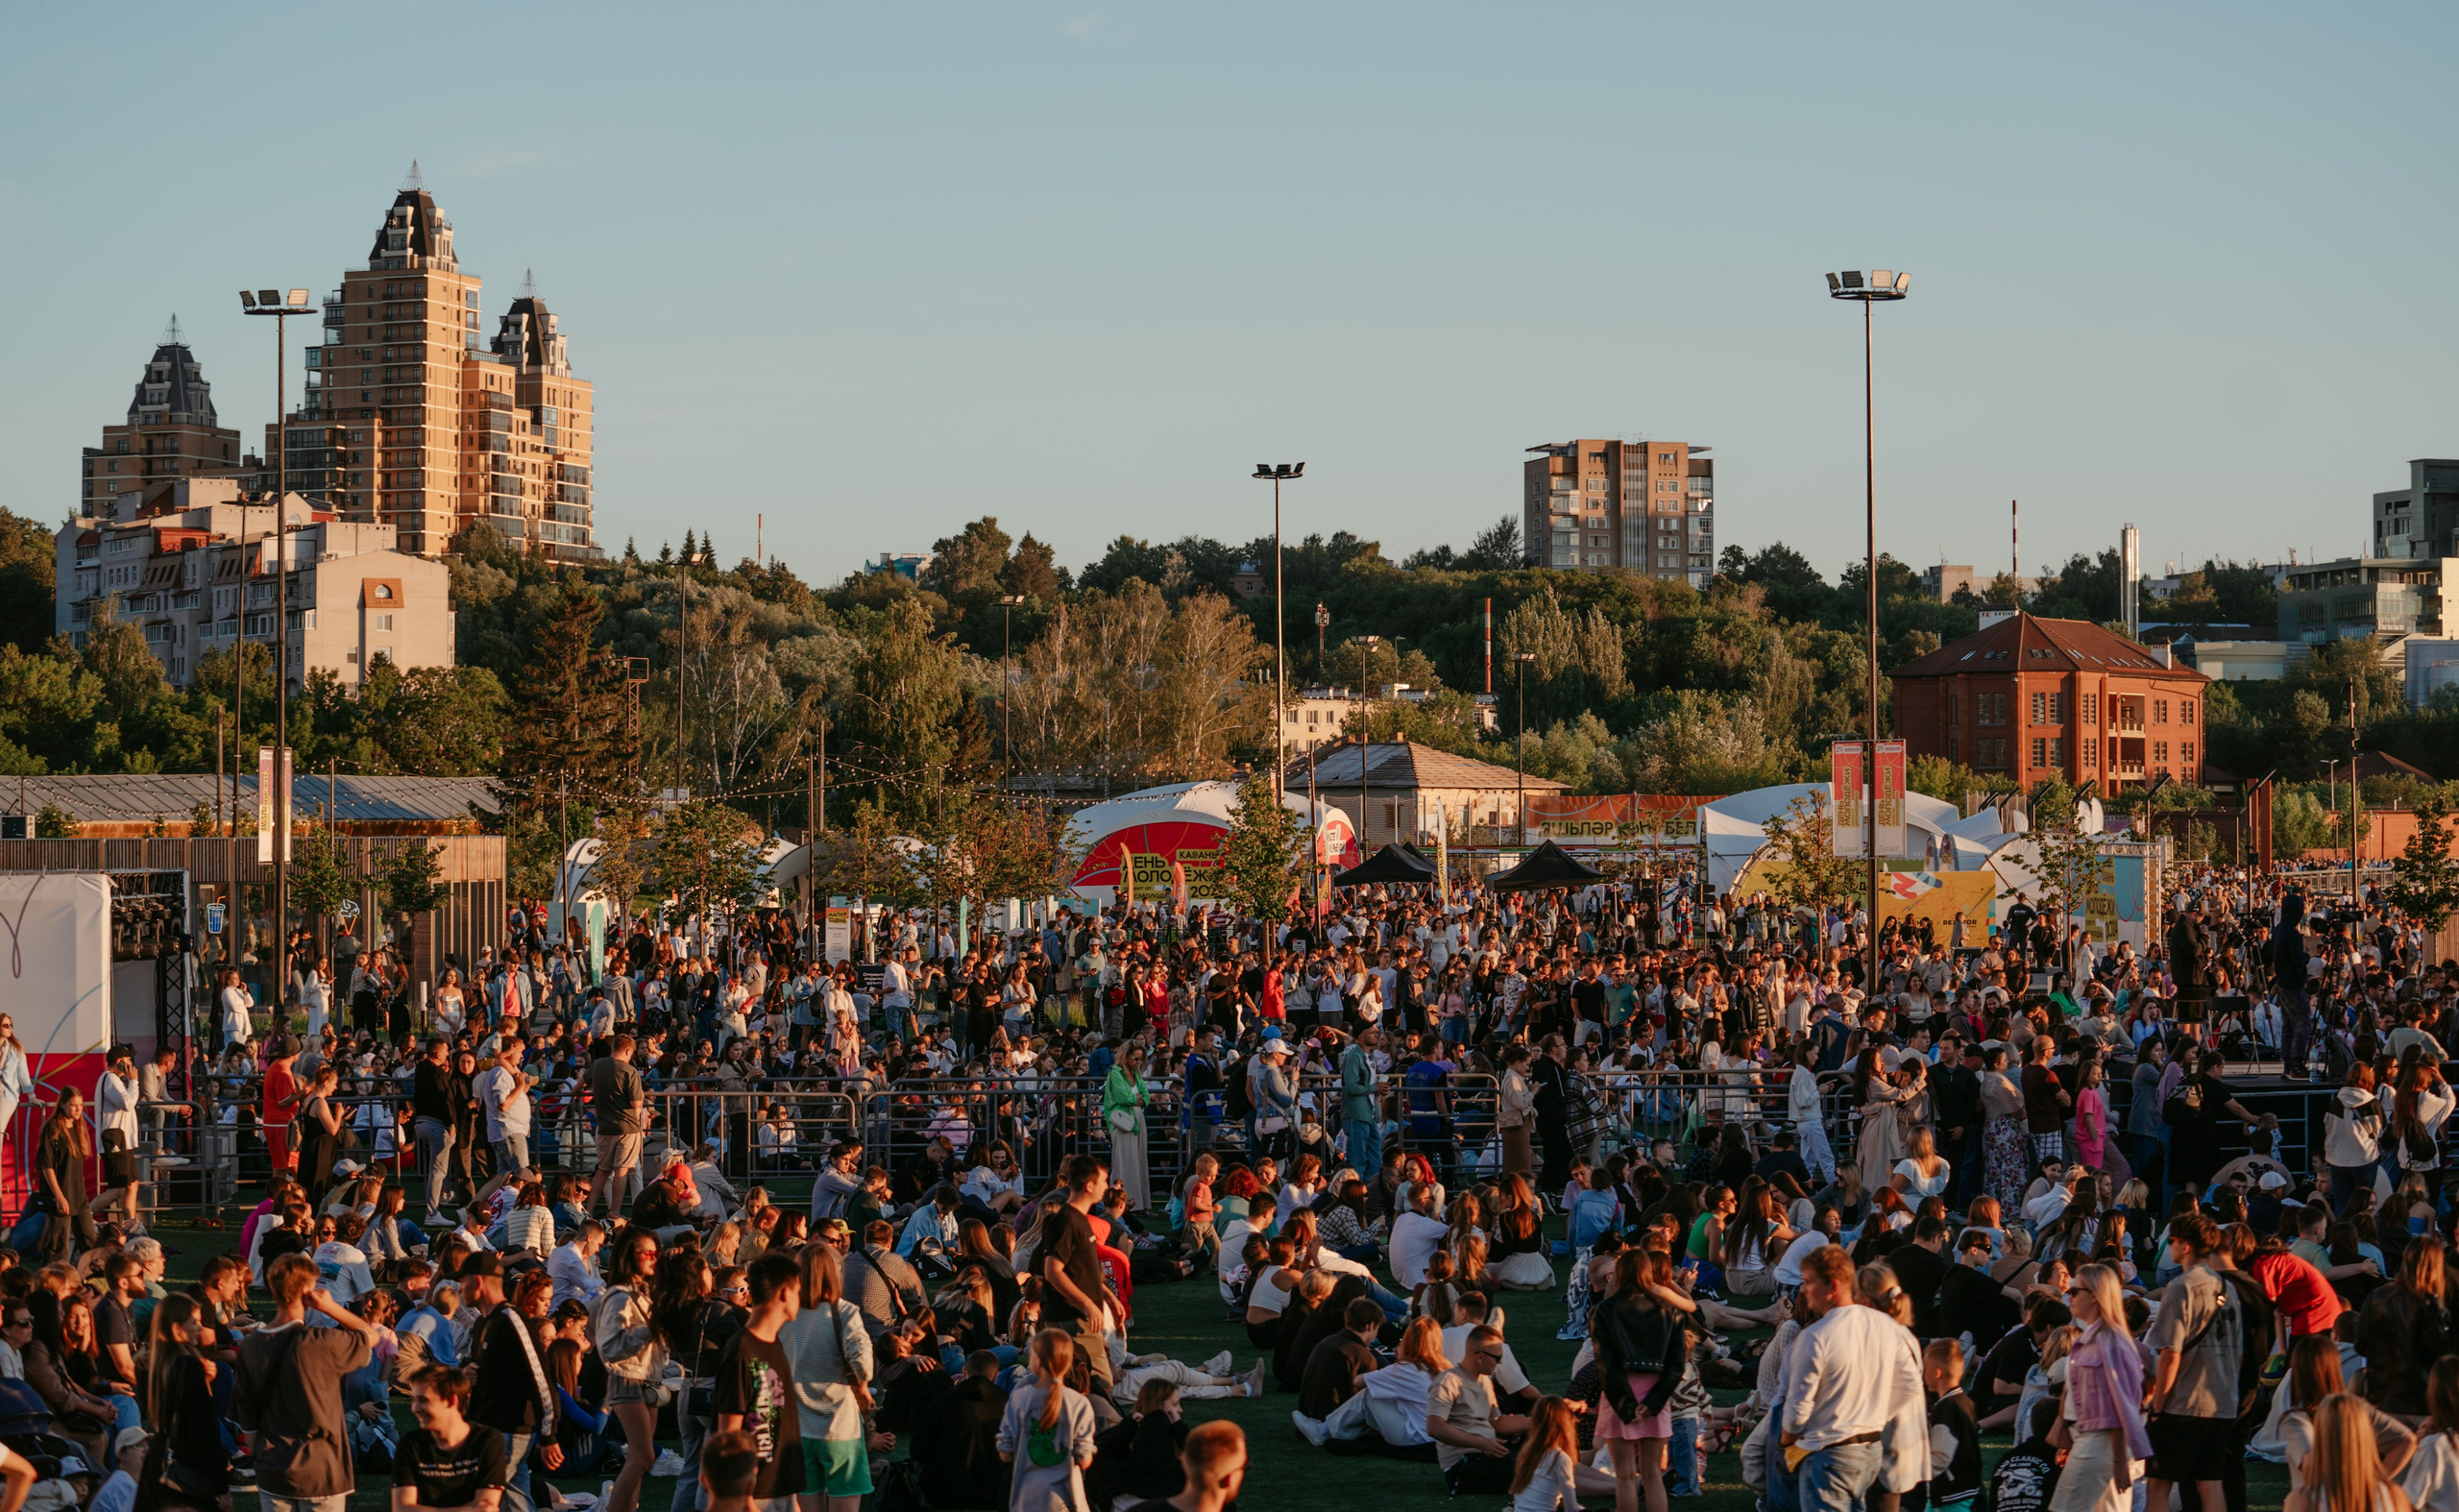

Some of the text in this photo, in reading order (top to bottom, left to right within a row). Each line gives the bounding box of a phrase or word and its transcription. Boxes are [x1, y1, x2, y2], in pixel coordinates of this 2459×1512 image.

[1843, 768, 1852, 826] МОЛОДЁЖИ
[1541, 821, 1614, 836] ЯШЬЛӘР
[1190, 885, 1218, 898] 202
[2010, 1455, 2043, 1465] CLASSIC
